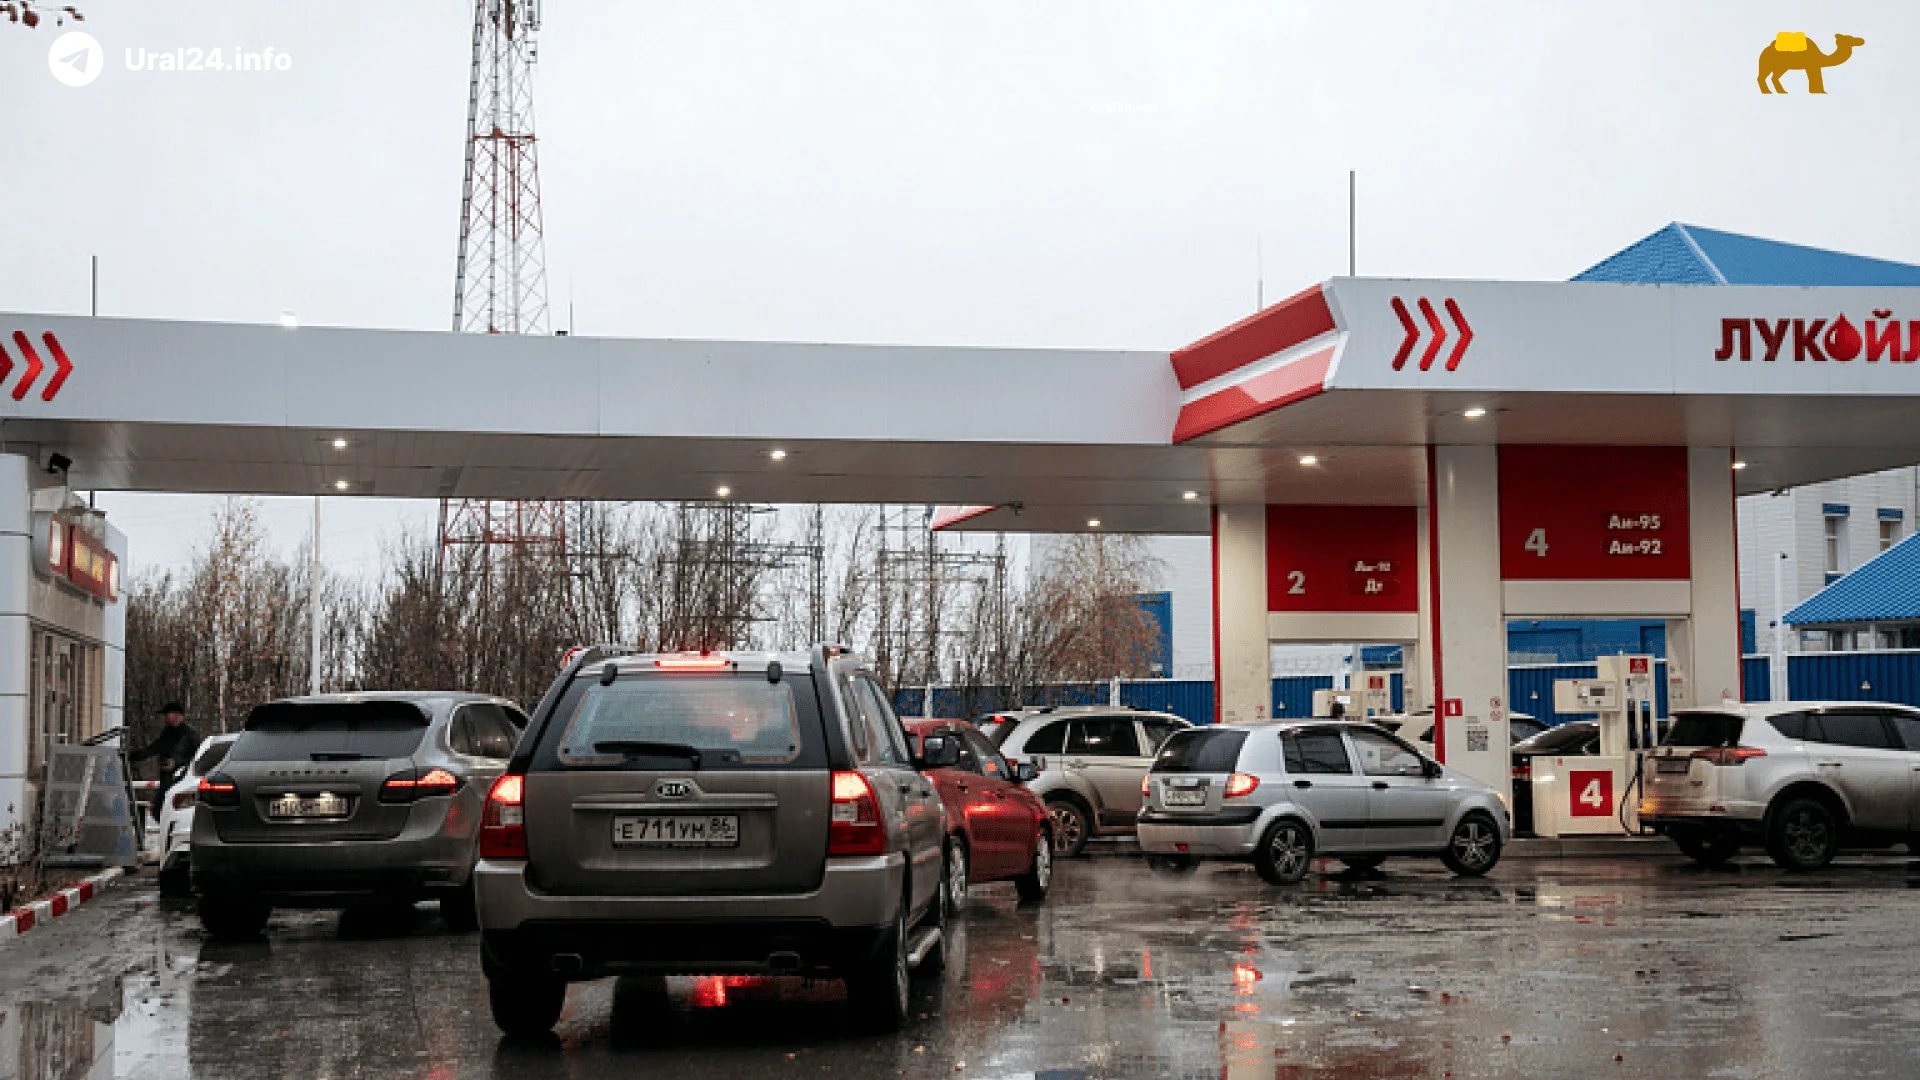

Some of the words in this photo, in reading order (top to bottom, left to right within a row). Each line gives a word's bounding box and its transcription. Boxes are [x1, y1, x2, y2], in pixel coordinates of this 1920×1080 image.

[1608, 513, 1661, 530] Аи-95
[1524, 527, 1549, 557] 4
[1608, 538, 1662, 555] Аи-92
[1286, 570, 1306, 595] 2
[1579, 779, 1603, 808] 4
